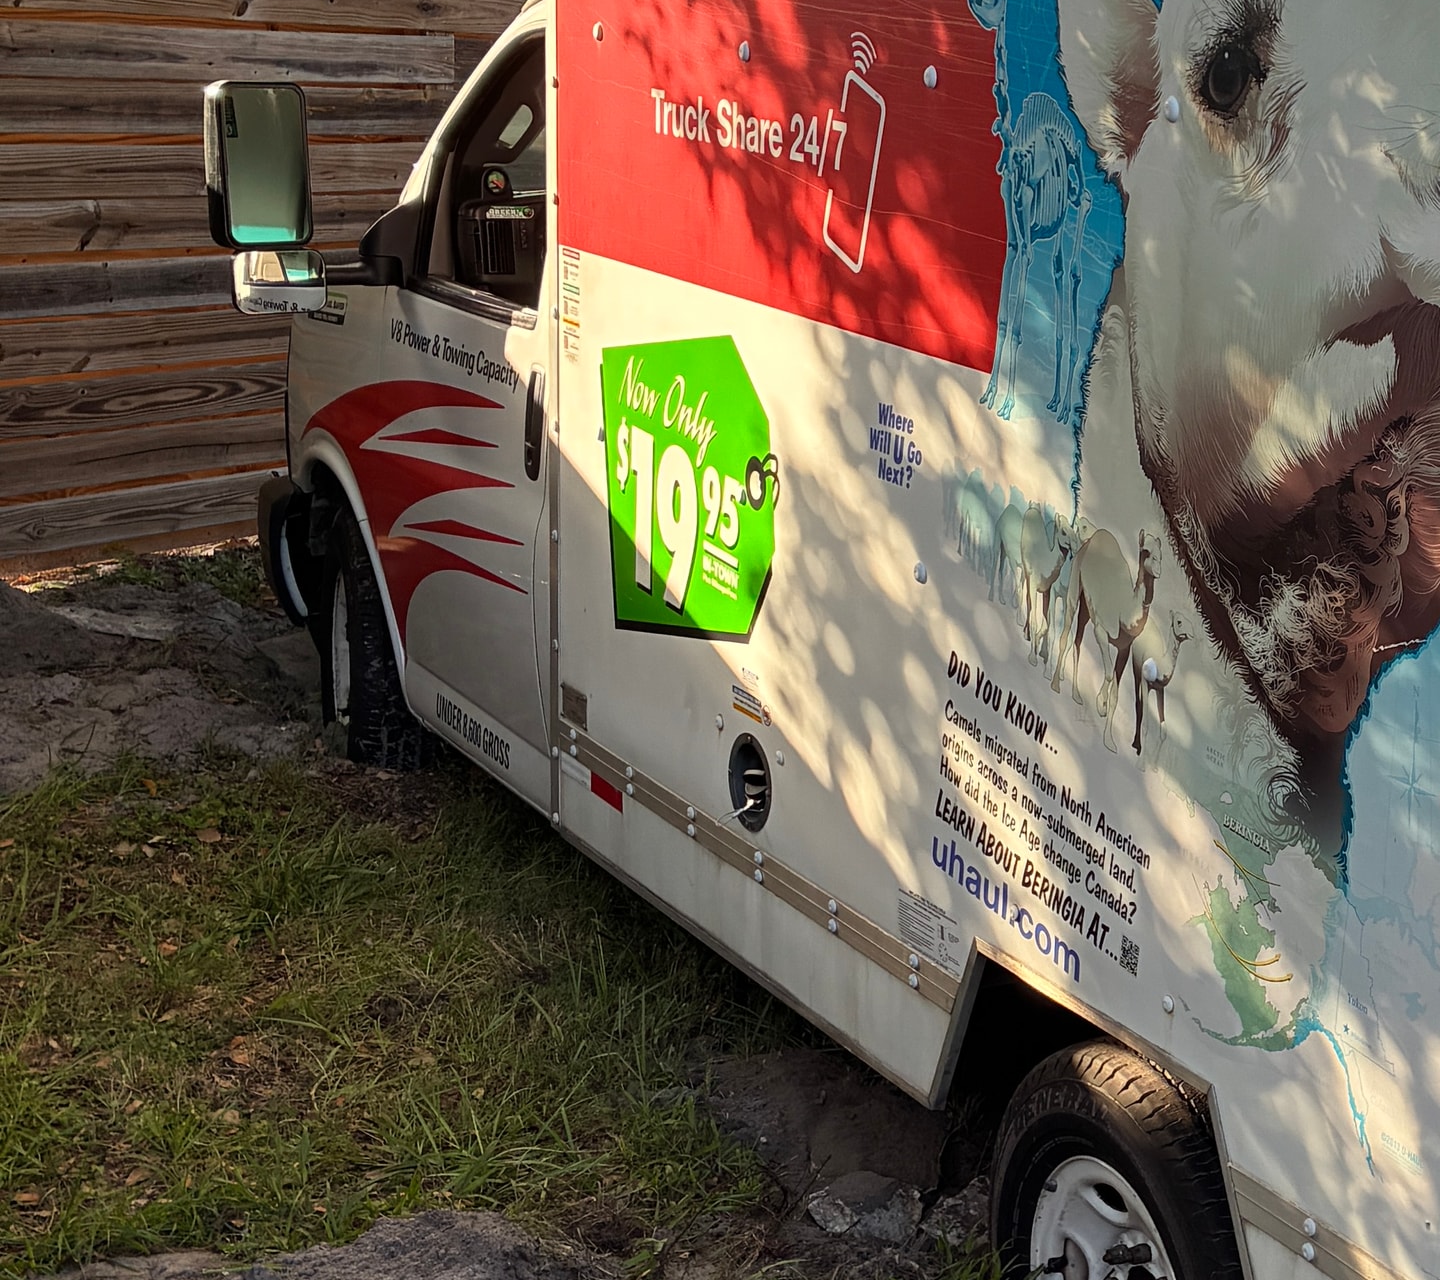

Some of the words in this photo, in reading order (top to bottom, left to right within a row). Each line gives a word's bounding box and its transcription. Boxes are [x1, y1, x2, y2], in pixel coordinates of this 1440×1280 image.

[650, 87, 711, 144] Truck
[716, 98, 784, 158] Share
[789, 108, 848, 177] 24/7
[391, 317, 403, 343] V8
[403, 323, 431, 355] Power
[431, 334, 440, 358] &
[442, 337, 475, 376] Towing
[476, 350, 521, 394] Capacity
[617, 355, 661, 419] Now
[662, 375, 718, 468] Only
[870, 427, 892, 455] Will
[893, 434, 905, 465] U
[907, 441, 922, 466] Go
[878, 402, 914, 434] Where
[702, 467, 742, 549] 95
[878, 457, 913, 489] Next?
[436, 692, 462, 734] UNDER
[483, 727, 510, 770] GROSS
[947, 650, 971, 688] DID
[974, 666, 1002, 712] YOU
[1004, 690, 1058, 755] KNOW...
[942, 732, 974, 768] origins
[977, 760, 1008, 795] across
[1011, 786, 1018, 801] a
[1021, 794, 1106, 870] now-submerged
[1109, 852, 1137, 894] land.
[945, 699, 982, 742] Camels
[984, 732, 1029, 778] migrated
[1031, 764, 1057, 800] from
[1060, 785, 1092, 827] North
[1095, 812, 1150, 870] American
[935, 787, 975, 842] LEARN
[976, 821, 1021, 877] ABOUT
[1021, 859, 1085, 935] BERINGIA
[1086, 912, 1119, 962] AT...
[938, 754, 961, 790] How
[964, 775, 979, 803] did
[983, 789, 998, 818] the
[1001, 802, 1016, 831] Ice
[1020, 819, 1041, 852] Age
[1043, 839, 1081, 884] change
[1085, 870, 1138, 925] Canada?
[1223, 814, 1272, 856] BERINGIA
